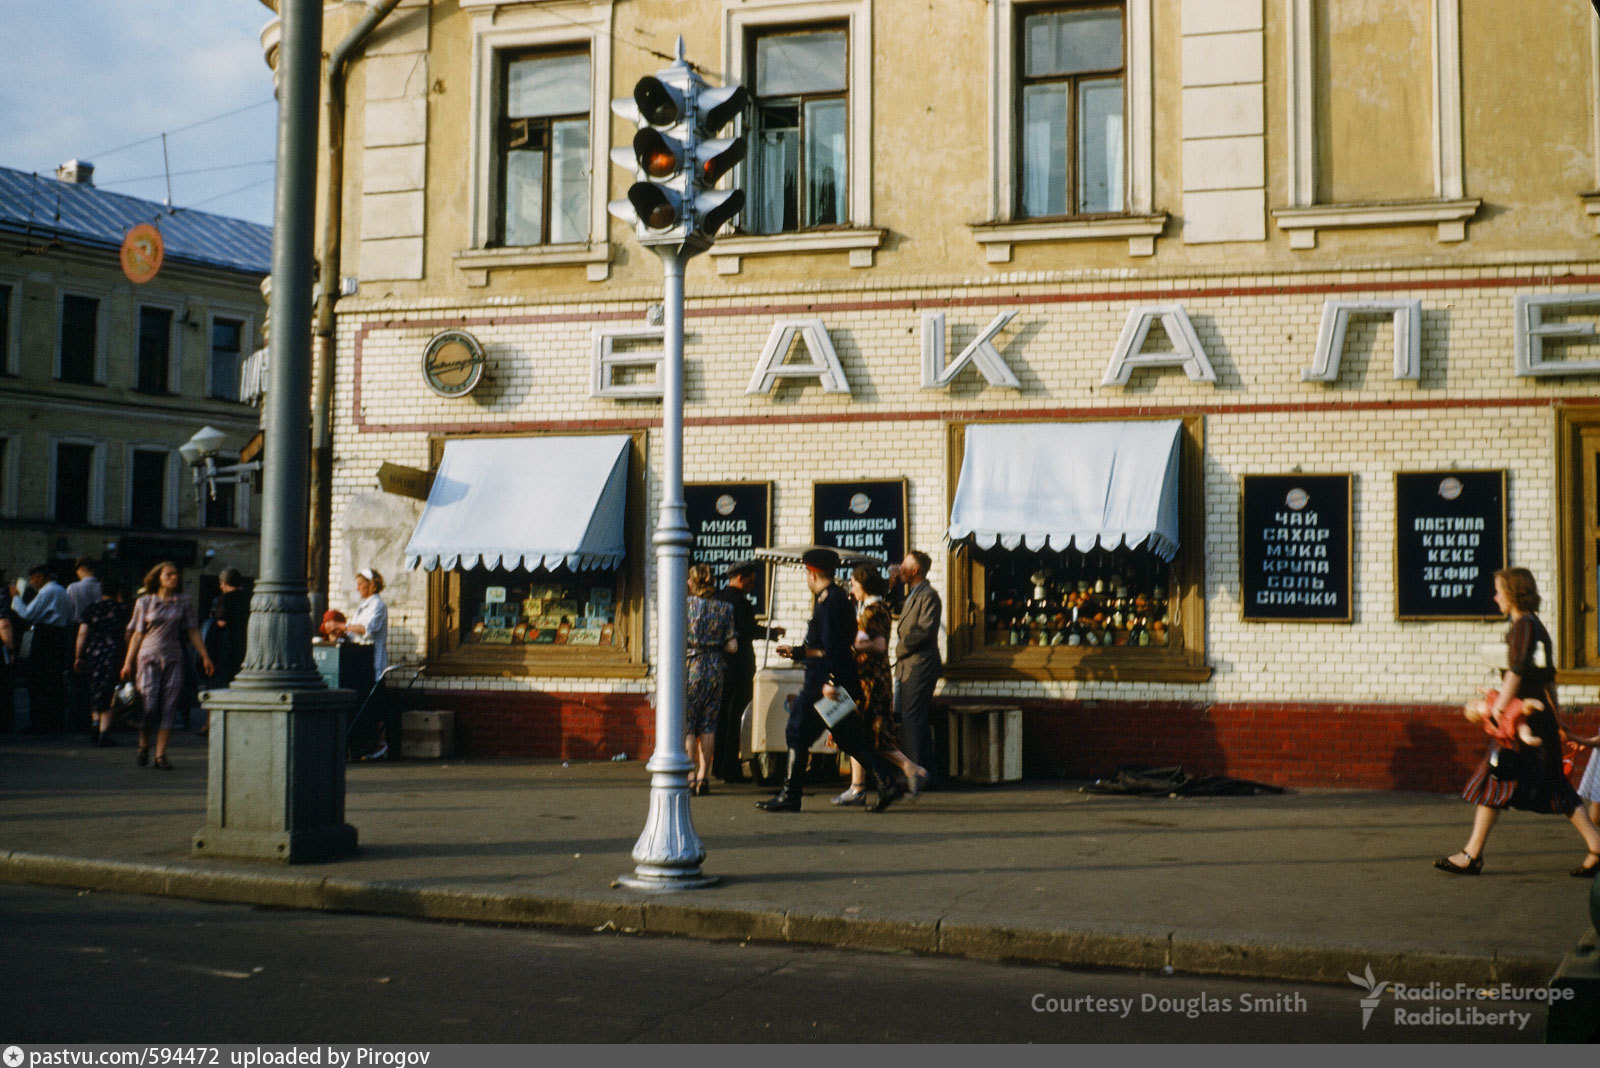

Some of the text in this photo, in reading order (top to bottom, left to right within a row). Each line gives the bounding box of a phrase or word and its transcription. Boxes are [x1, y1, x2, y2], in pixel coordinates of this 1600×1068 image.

[823, 518, 897, 532] ПАПИРОСЫ
[1275, 511, 1318, 526] ЧАЙ
[1414, 517, 1485, 531] ПАСТИЛА
[701, 520, 748, 533] МУКА
[696, 534, 753, 548] ПШЕНО
[835, 533, 885, 547] ТАБАК
[1263, 528, 1330, 542] САХАР
[1422, 534, 1480, 547] КАКАО
[693, 549, 756, 563] ЯДРИЦА
[1266, 544, 1328, 558] МУКА
[1428, 549, 1475, 563] КЕКС
[1263, 560, 1330, 574] КРУПА
[1423, 566, 1480, 581] ЗЕФИР
[1267, 575, 1325, 590] СОЛЬ
[1256, 590, 1338, 605] СПИЧКИ
[1429, 584, 1475, 598] ТОРТ
